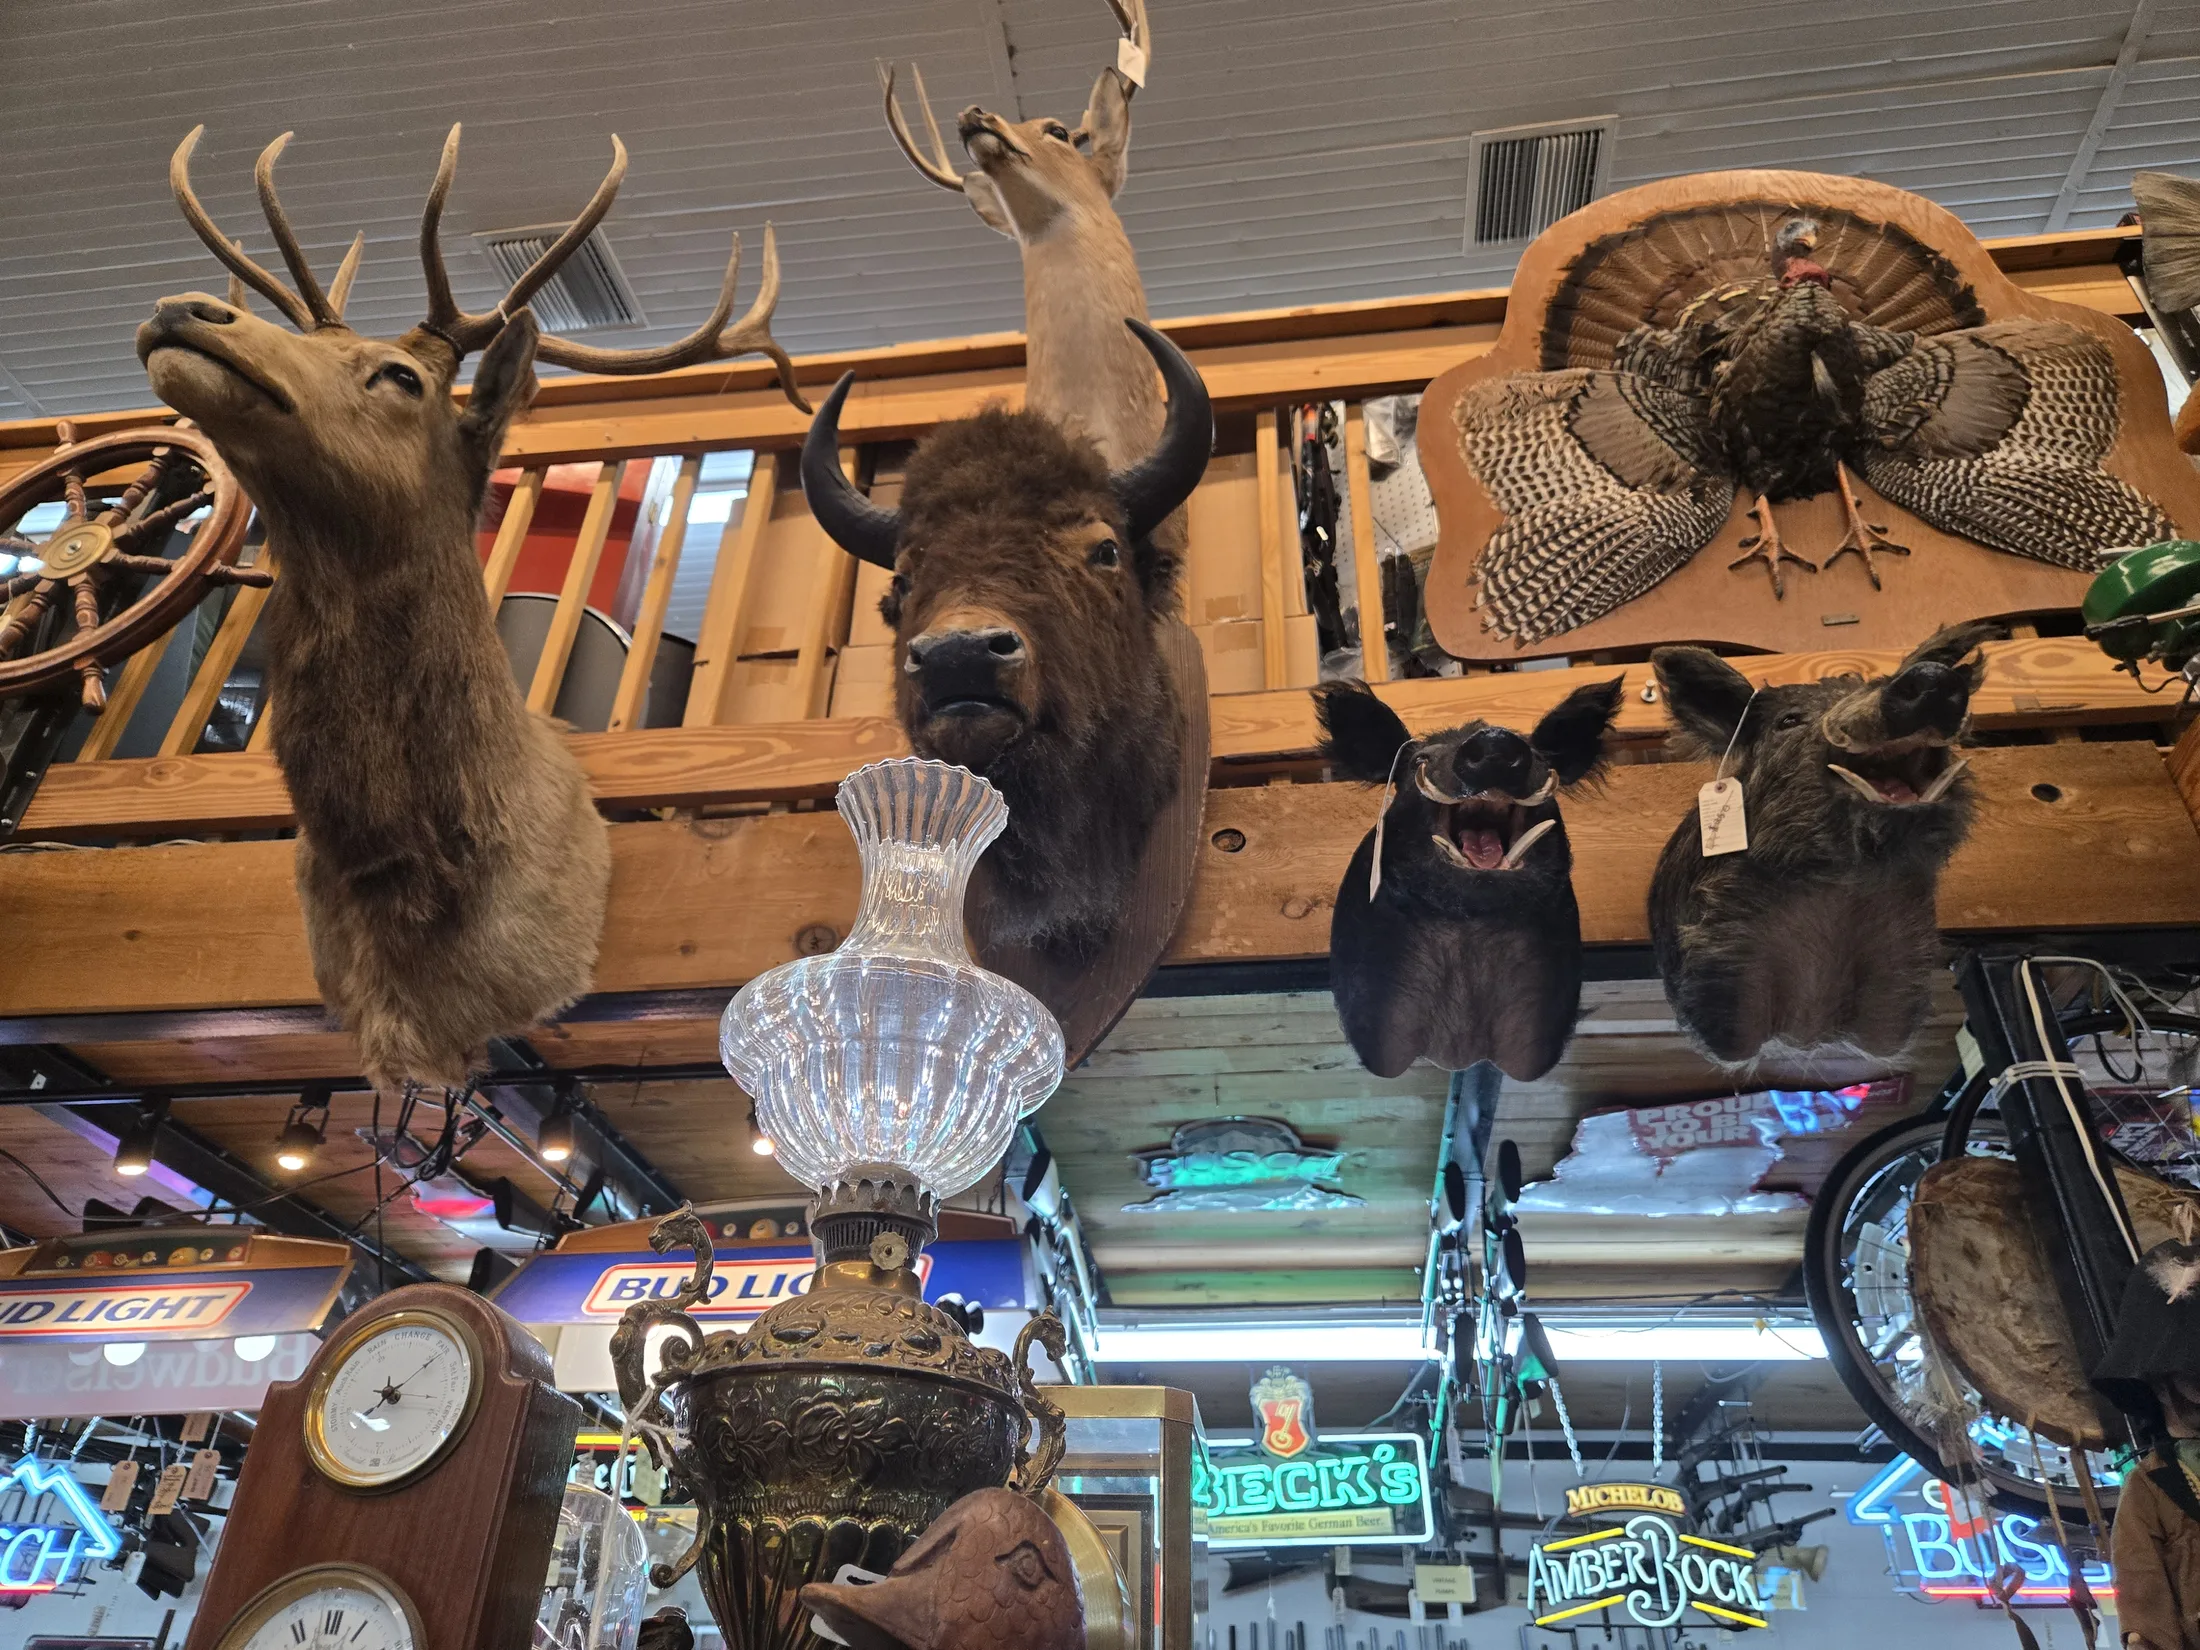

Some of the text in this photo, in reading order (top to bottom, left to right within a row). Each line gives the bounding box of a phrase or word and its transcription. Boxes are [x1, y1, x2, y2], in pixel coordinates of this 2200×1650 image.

[0, 1295, 226, 1324] UD LIGHT
[367, 1338, 388, 1354] RAIN
[394, 1332, 432, 1342] CHANGE
[435, 1339, 450, 1356] FAIR
[331, 1403, 339, 1433] STORMY
[1193, 1444, 1422, 1517] BECK'S
[1566, 1486, 1686, 1513] MICHELOB
[1261, 1519, 1305, 1533] Favorite
[1308, 1516, 1352, 1530] German
